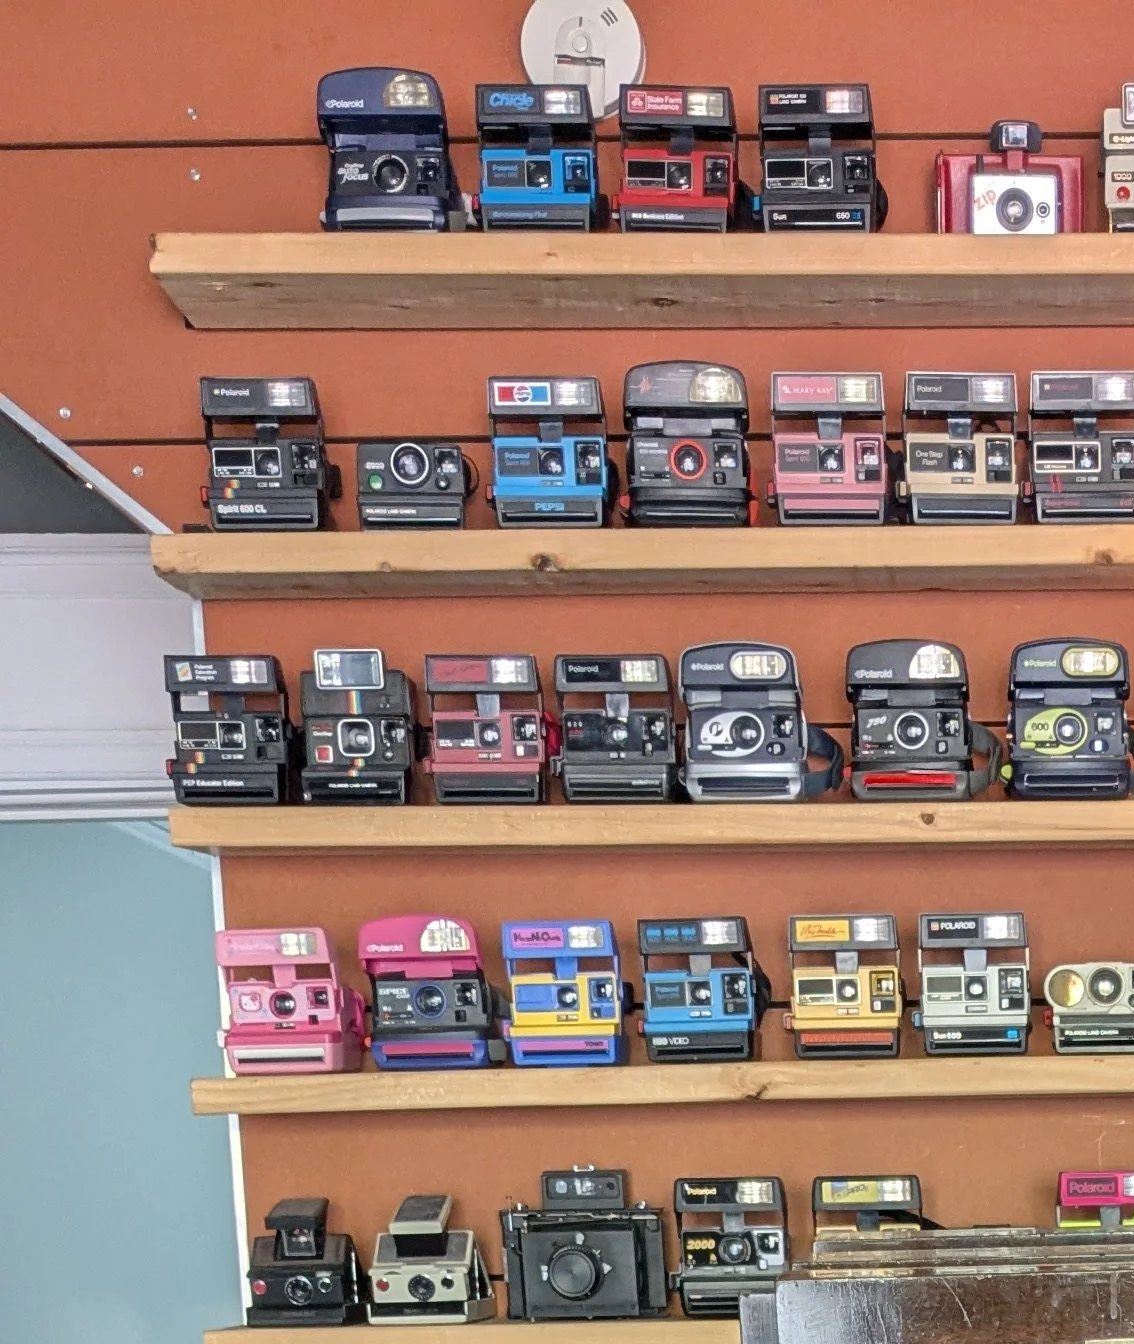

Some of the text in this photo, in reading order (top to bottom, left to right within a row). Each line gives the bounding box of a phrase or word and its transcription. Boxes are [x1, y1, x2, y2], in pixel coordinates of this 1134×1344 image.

[331, 99, 364, 108] Polaroid
[648, 95, 664, 103] State
[793, 387, 812, 395] MARY
[929, 450, 943, 459] Step
[535, 502, 564, 511] PEPSI
[1029, 660, 1057, 668] Polaroid
[568, 665, 599, 673] Polaroid
[861, 670, 892, 678] Polaroid
[1032, 722, 1049, 731] 600
[941, 921, 975, 930] POLAROID
[370, 944, 403, 953] Polaroid
[1070, 1181, 1115, 1193] Polaroid
[687, 1240, 715, 1249] 2000
